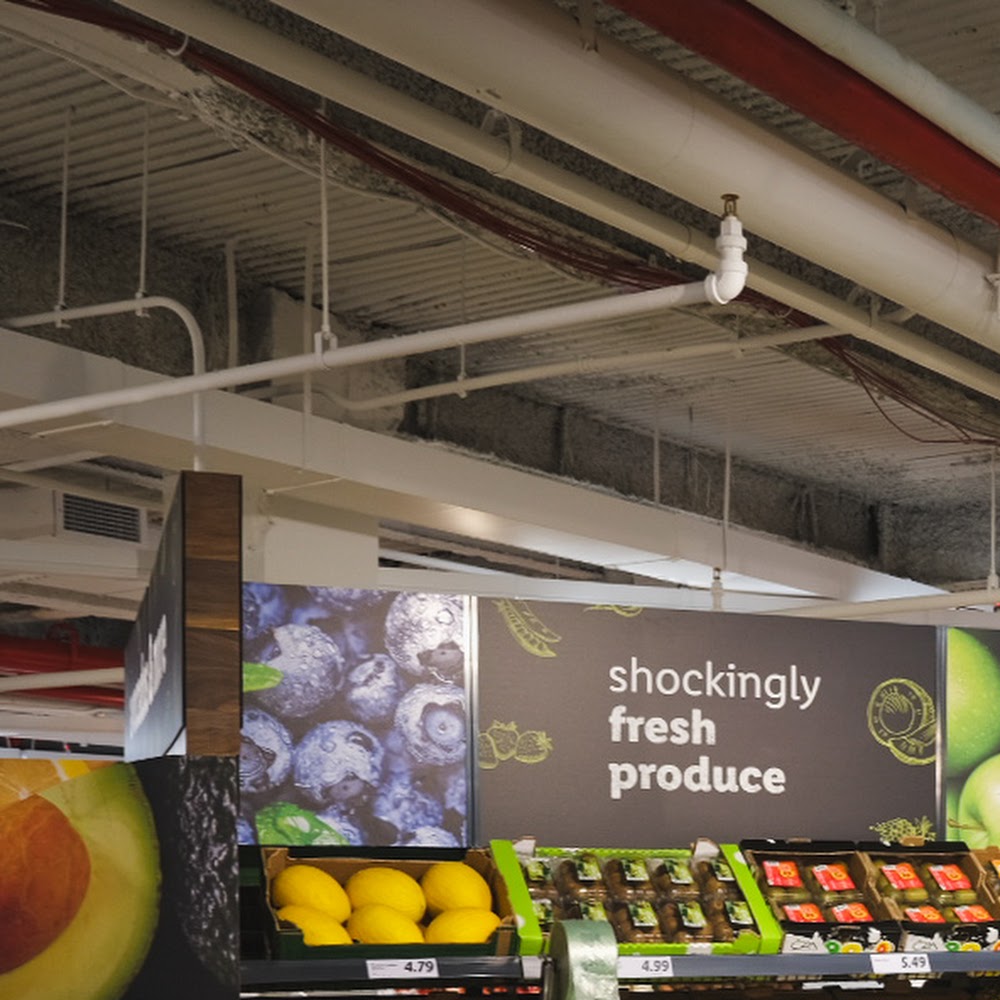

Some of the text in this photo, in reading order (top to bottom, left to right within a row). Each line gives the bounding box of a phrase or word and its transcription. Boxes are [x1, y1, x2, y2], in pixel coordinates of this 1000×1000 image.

[609, 656, 821, 710] shockingly
[608, 705, 716, 745] fresh
[608, 756, 786, 800] produce
[404, 961, 434, 973] 4.79
[641, 960, 670, 972] 4.99
[901, 956, 927, 969] 5.49
